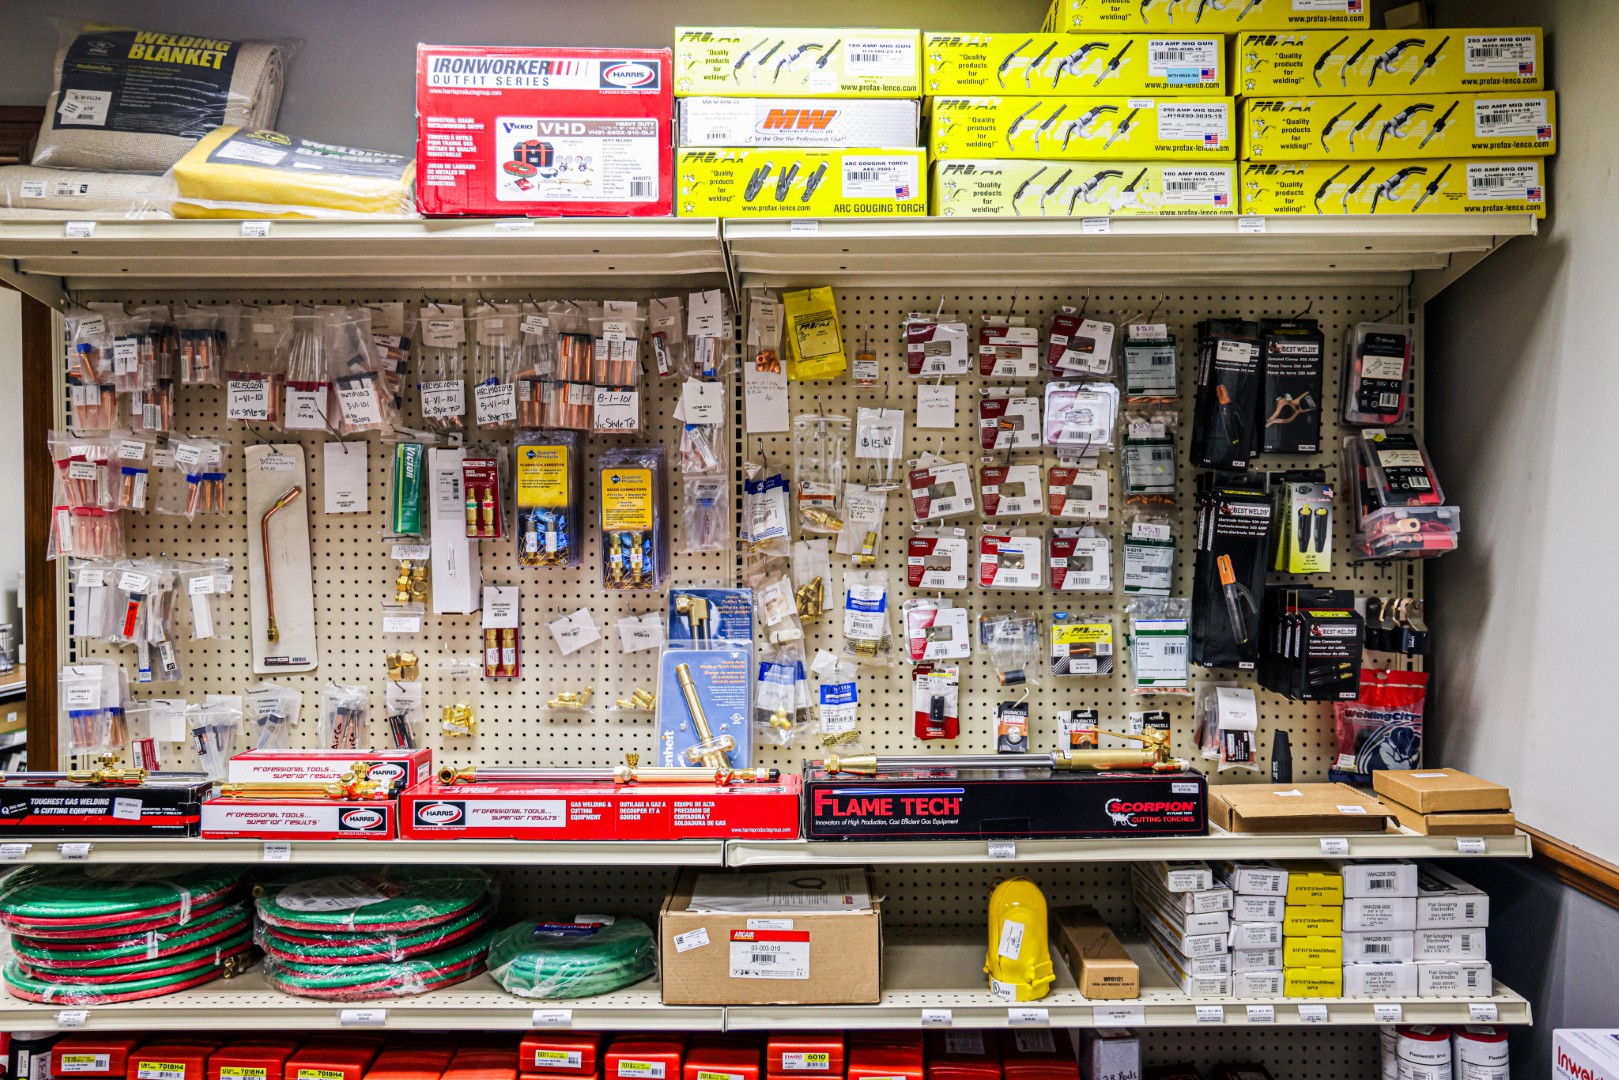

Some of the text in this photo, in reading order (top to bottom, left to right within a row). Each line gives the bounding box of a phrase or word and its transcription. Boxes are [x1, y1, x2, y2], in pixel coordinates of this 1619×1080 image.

[1288, 14, 1365, 24] www.profax-lenco.com
[134, 30, 232, 52] WELDING
[127, 43, 228, 70] BLANKET
[432, 57, 550, 76] IRONWORKER
[958, 62, 988, 70] products
[1273, 60, 1303, 68] products
[1284, 68, 1294, 76] for
[432, 75, 550, 87] OUTFIT SERIES
[1461, 77, 1538, 86] www.profax-lenco.com
[428, 88, 502, 96] www.harrisproductsgroup.com
[840, 83, 917, 92] www.profax-lenco.com
[762, 110, 838, 130] MW
[538, 122, 586, 135] VHD
[1472, 140, 1549, 150] www.profax-lenco.com
[709, 178, 734, 186] products
[717, 186, 726, 194] for
[742, 204, 811, 212] www.profax-lenco.com
[834, 204, 924, 213] ARC GOUGING TORCH
[1464, 204, 1541, 213] www.profax-lenco.com
[606, 417, 623, 428] Style
[405, 446, 414, 480] VICTOR
[1233, 507, 1268, 516] BEST WELDS
[1344, 708, 1415, 722] WeldingCity
[30, 798, 110, 806] TOUGHEST GAS WELDING
[814, 789, 960, 817] FLAME TECH
[69, 807, 107, 815] EQUIPMENT
[1110, 801, 1194, 813] SCORPION
[841, 818, 848, 826] of
[847, 818, 860, 826] High
[860, 818, 888, 826] Production,
[932, 818, 959, 826] Equipment
[807, 1054, 826, 1062] 6010
[241, 1068, 265, 1076] 7018H4
[317, 1070, 343, 1078] 7018H4
[700, 1072, 712, 1080] 7018
